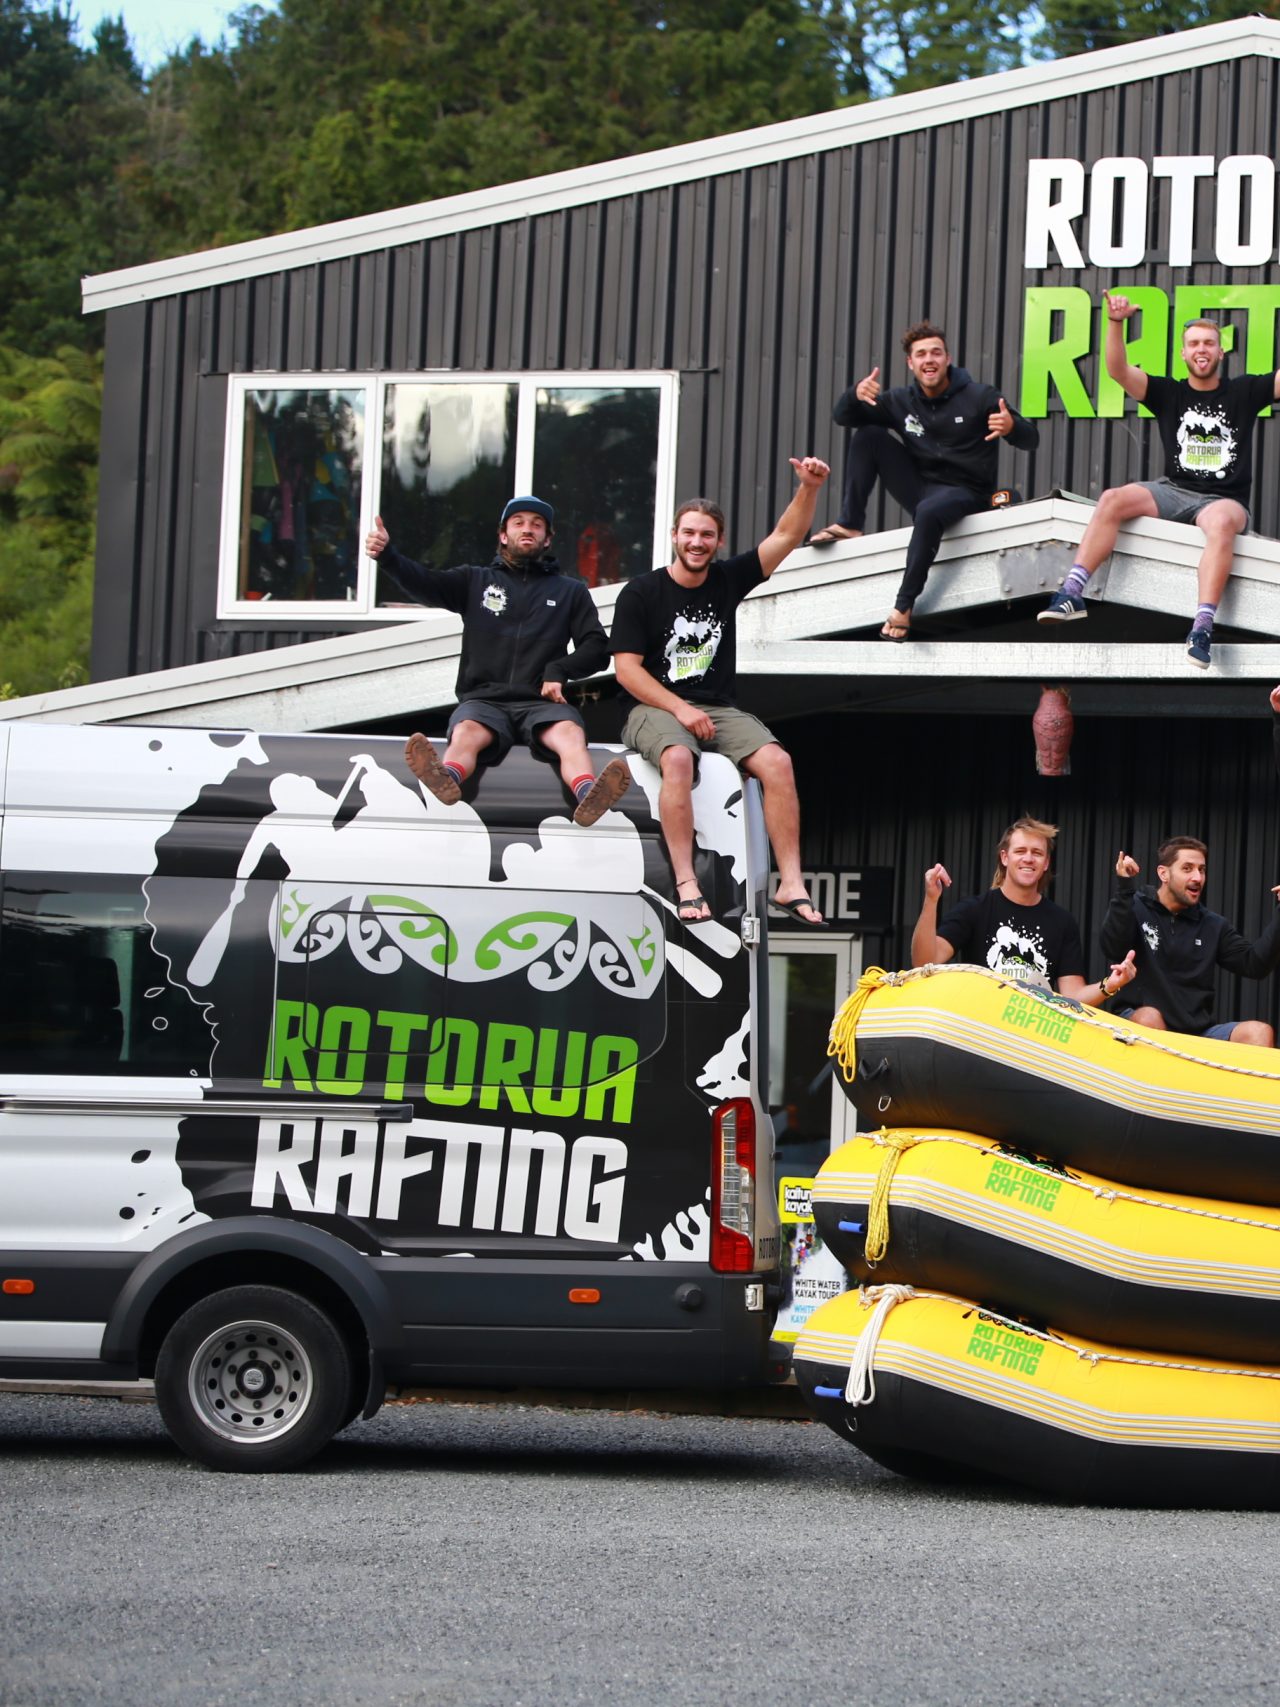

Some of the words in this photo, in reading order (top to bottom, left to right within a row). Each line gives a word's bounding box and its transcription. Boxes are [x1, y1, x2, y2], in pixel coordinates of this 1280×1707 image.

[1187, 445, 1222, 455] ROTORUA
[1002, 1005, 1073, 1043] RAFTING
[1009, 993, 1077, 1027] ROTORUA
[262, 999, 639, 1124] ROTORUA
[251, 1116, 628, 1243] RAFTING
[984, 1173, 1057, 1212] RAFTING
[991, 1160, 1062, 1193] ROTORUA
[795, 1279, 816, 1288] WHITE
[818, 1281, 841, 1290] WATER
[795, 1289, 817, 1298] KAYAK
[967, 1337, 1039, 1376] RAFTING
[974, 1323, 1045, 1357] ROTORUA
